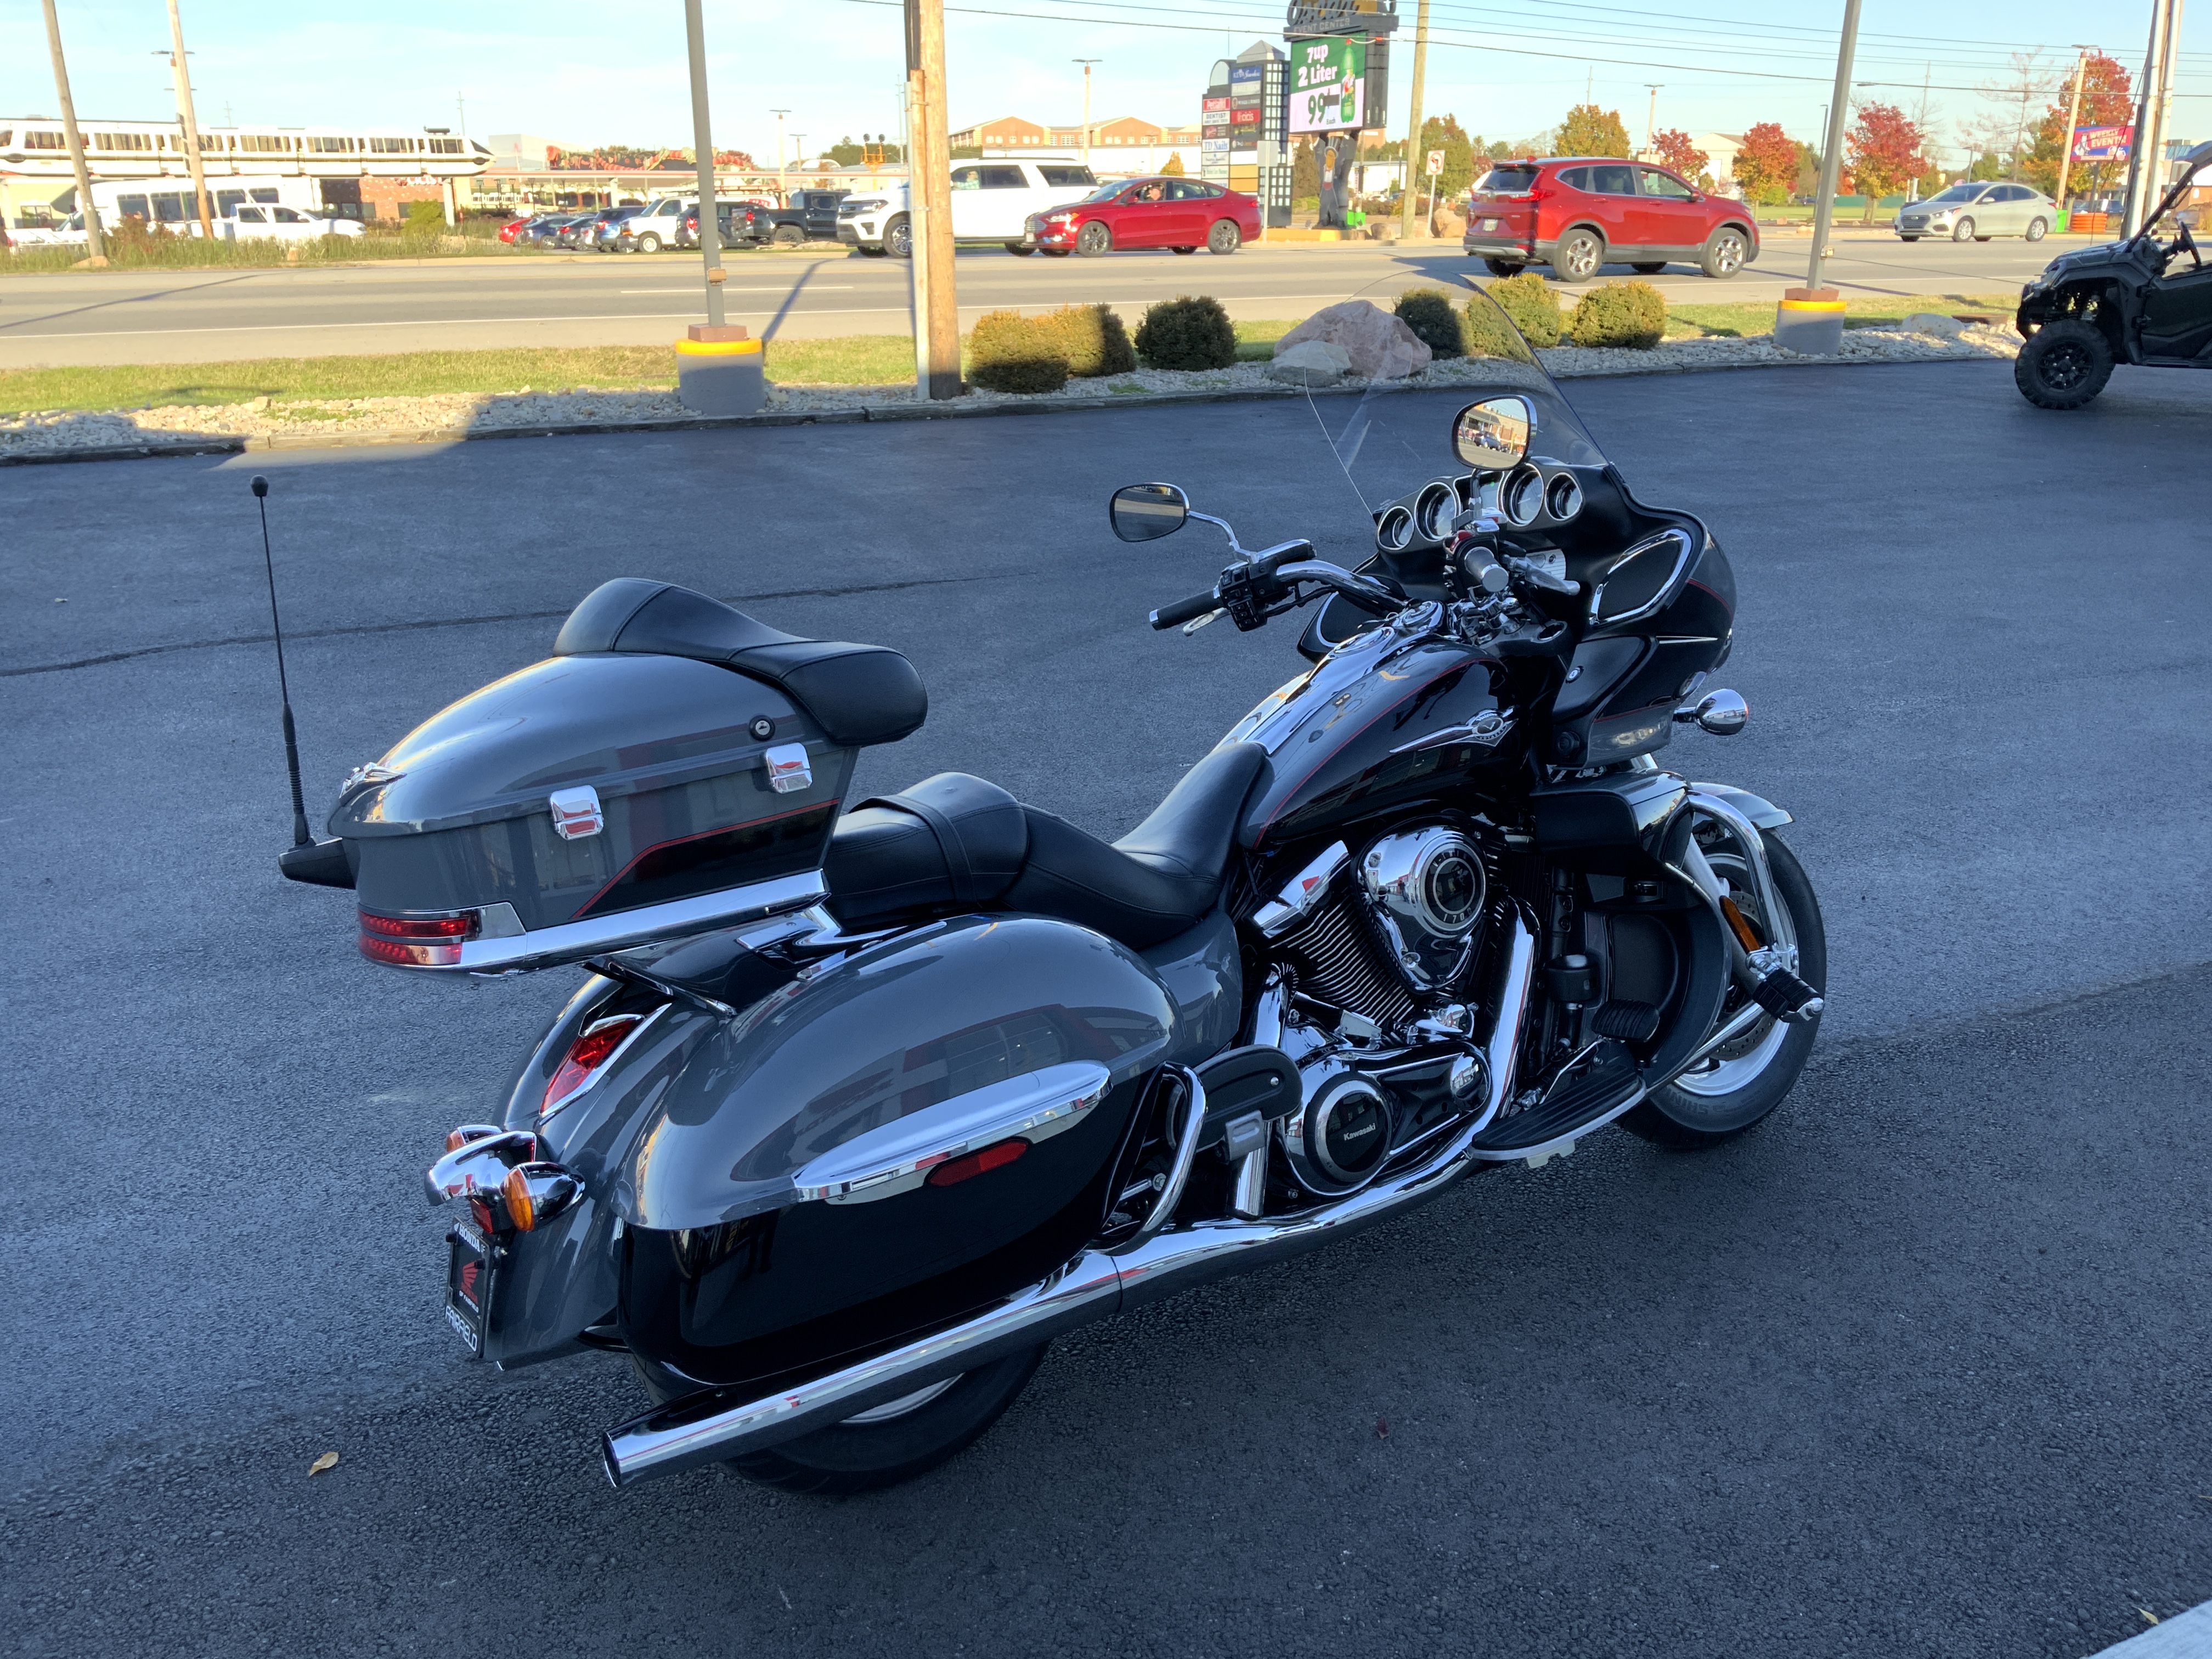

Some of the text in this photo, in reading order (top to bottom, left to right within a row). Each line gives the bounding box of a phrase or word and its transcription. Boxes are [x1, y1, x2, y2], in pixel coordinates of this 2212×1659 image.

[1294, 18, 1350, 33] EVENT CENTER
[1306, 44, 1329, 63] 7up
[1297, 64, 1338, 87] 2 Liter
[2090, 128, 2120, 139] WEEKLY
[2091, 134, 2127, 148] EVENTS!
[1204, 141, 1212, 150] TD
[1214, 140, 1228, 150] Nails
[1443, 907, 1472, 923] 1700
[1344, 1122, 1376, 1141] Kawasaki
[459, 1223, 481, 1252] HONDA
[445, 1305, 478, 1352] FAIRFIELD
